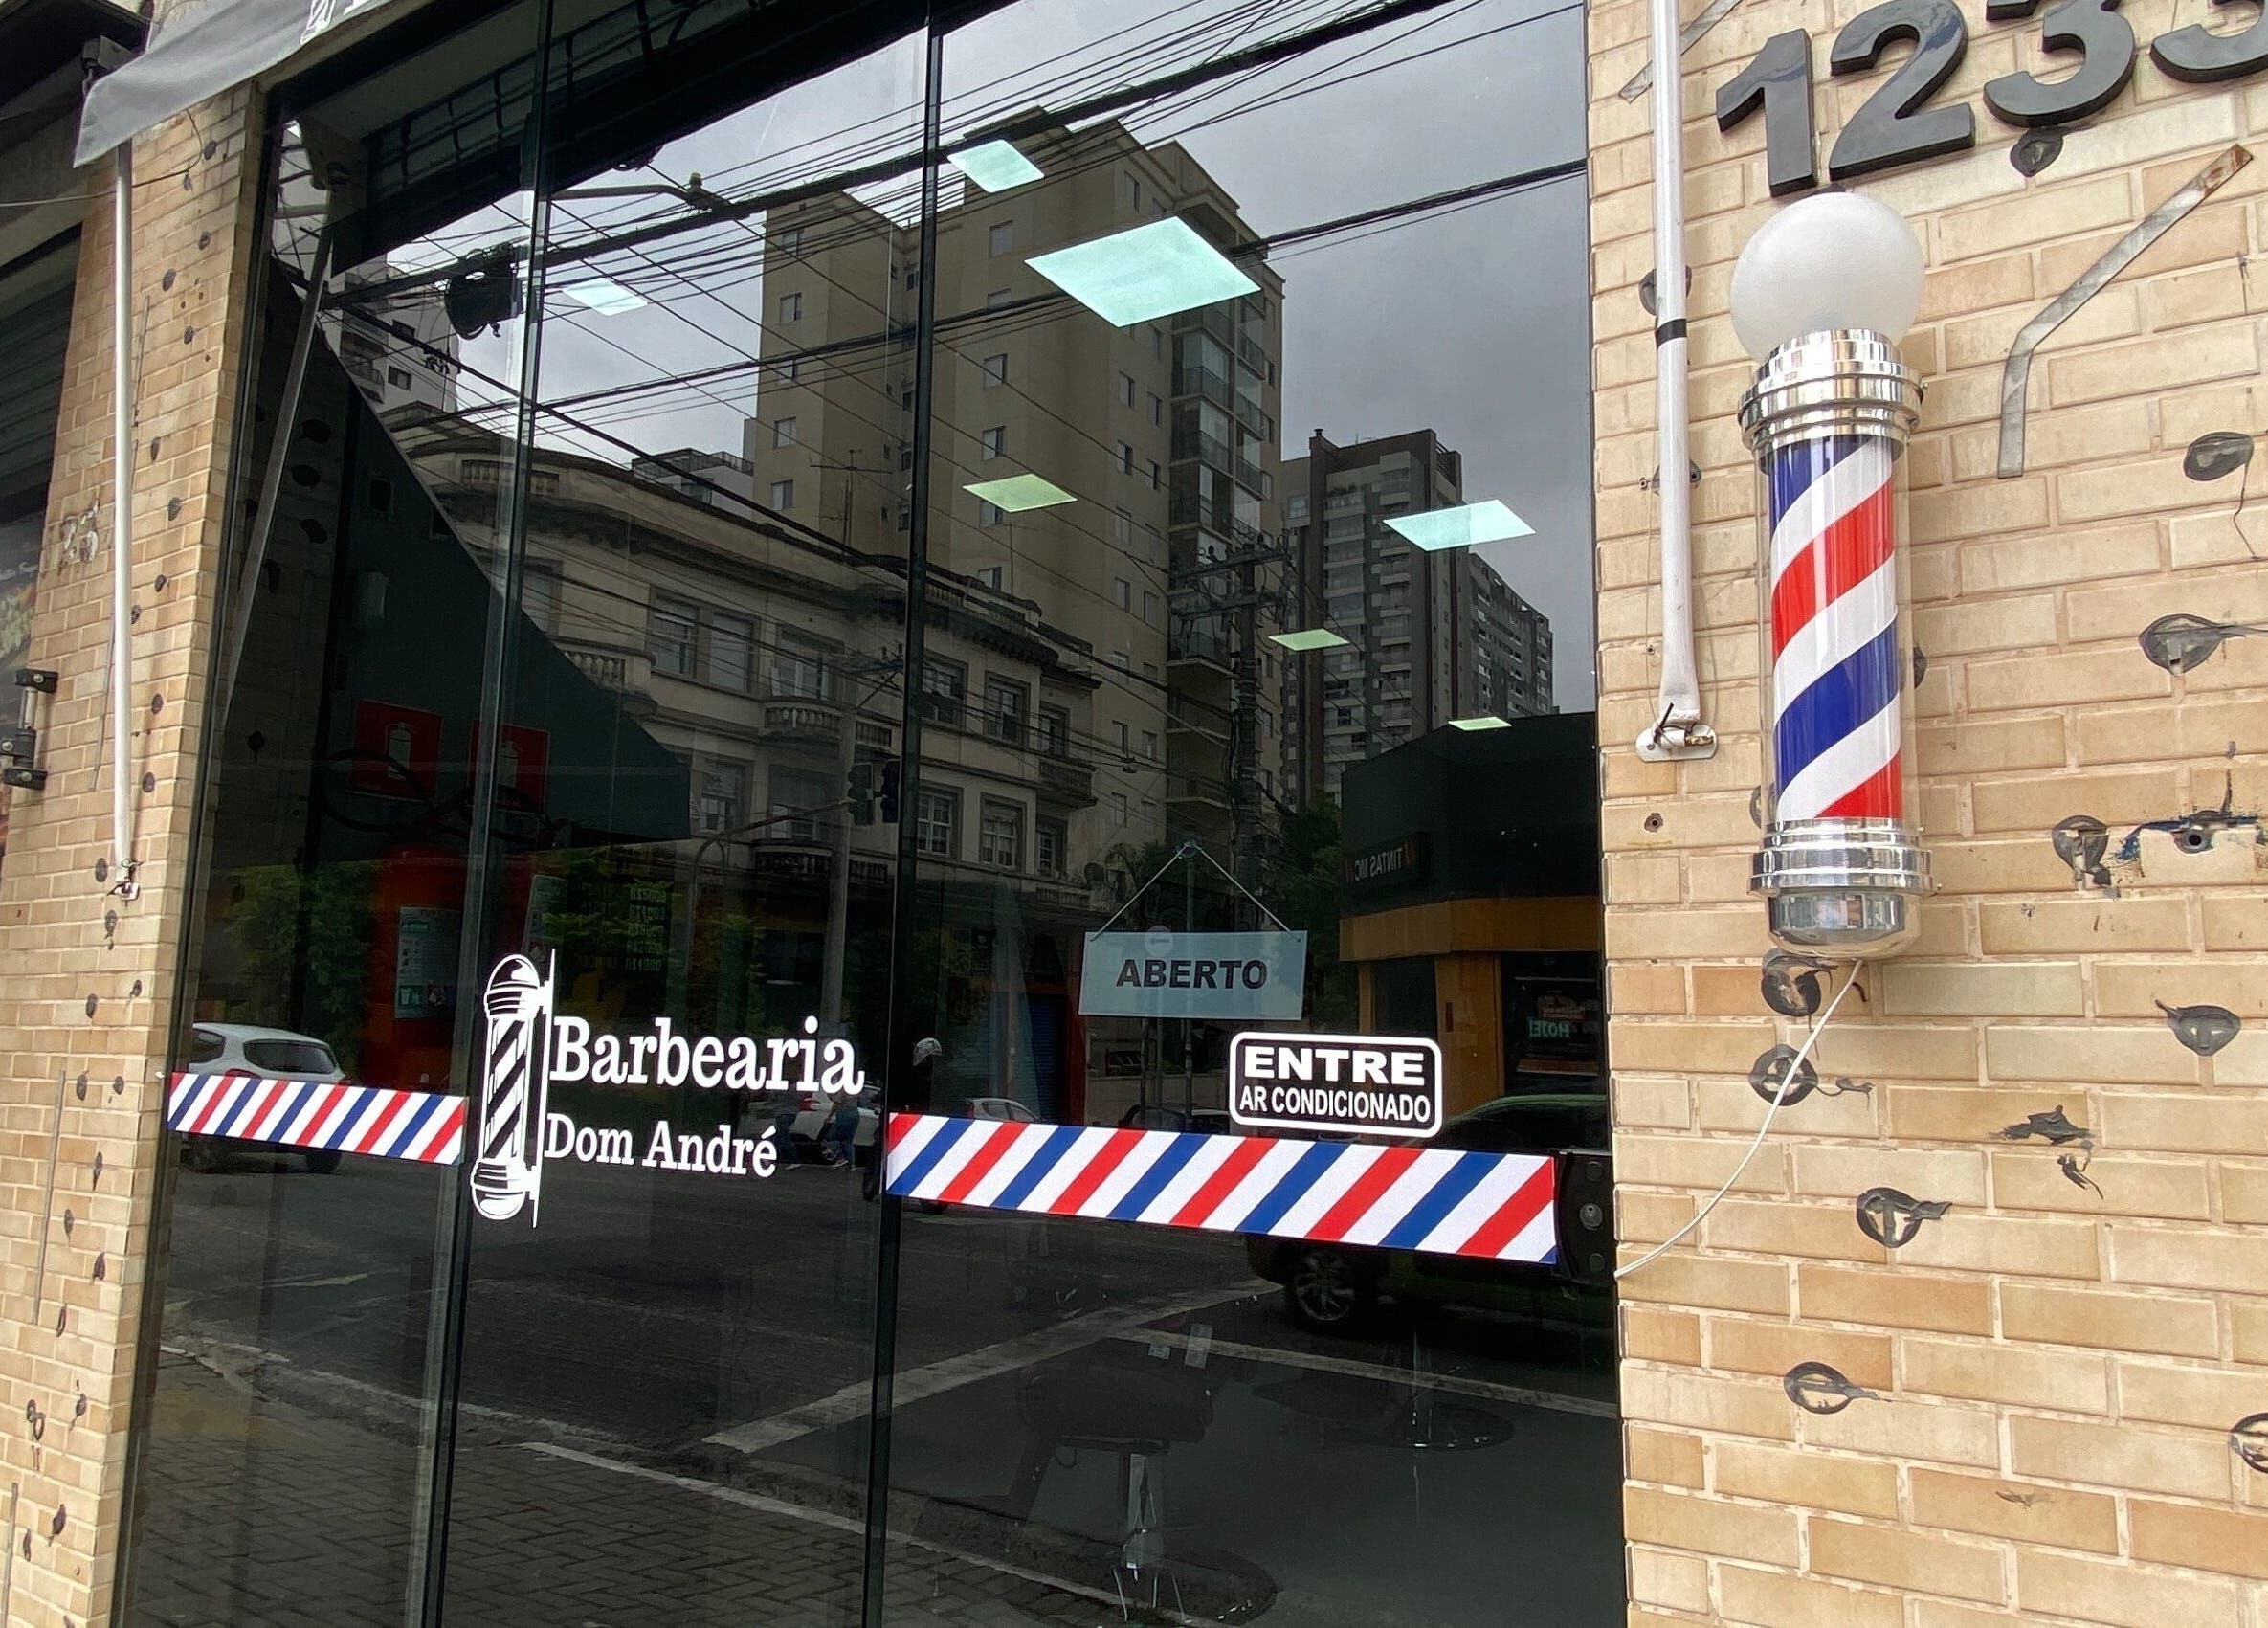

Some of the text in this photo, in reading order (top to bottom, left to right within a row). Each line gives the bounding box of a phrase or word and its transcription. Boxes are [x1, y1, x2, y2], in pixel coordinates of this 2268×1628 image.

[1115, 958, 1268, 990] ABERTO
[549, 1015, 865, 1096] Barbearia
[1244, 1046, 1426, 1086] ENTRE
[1239, 1085, 1432, 1123] AR CONDICIONADO
[544, 1112, 779, 1178] Dom André
